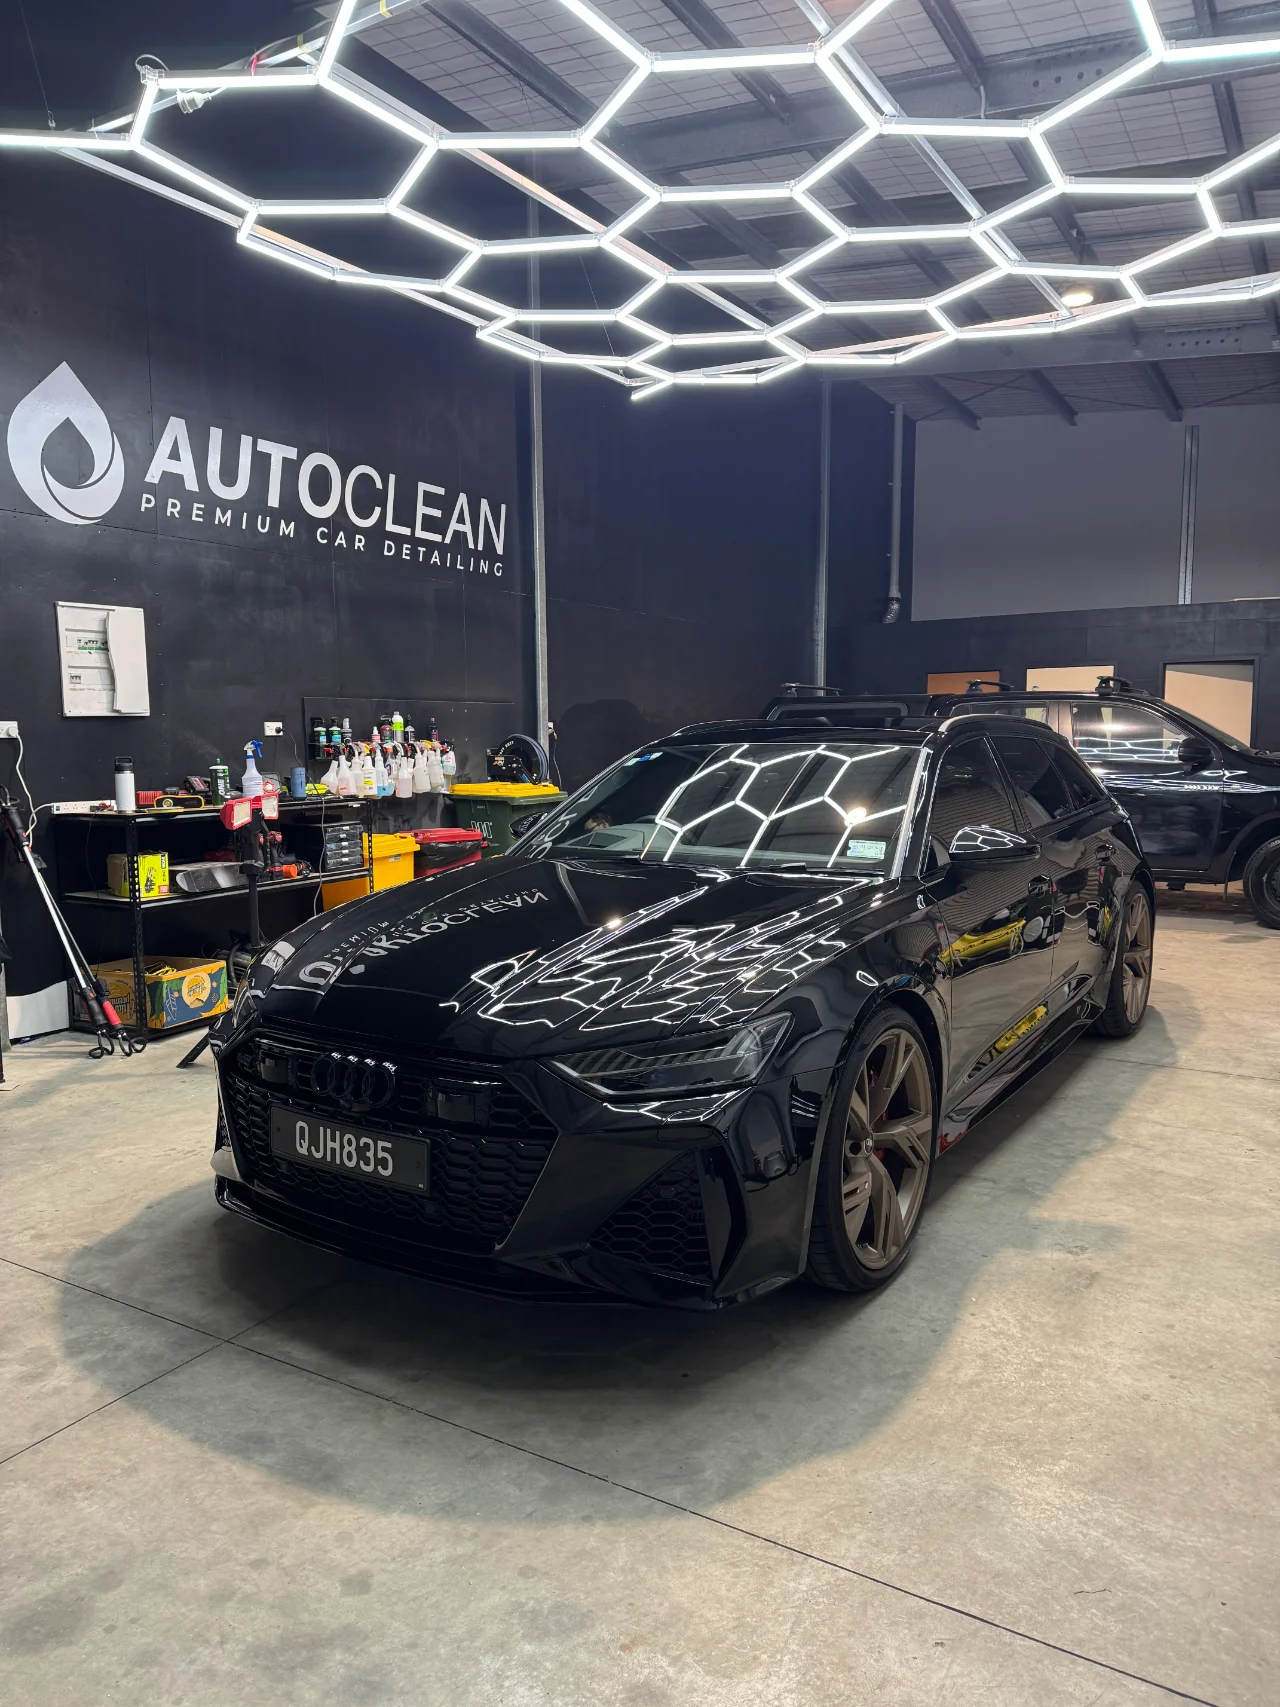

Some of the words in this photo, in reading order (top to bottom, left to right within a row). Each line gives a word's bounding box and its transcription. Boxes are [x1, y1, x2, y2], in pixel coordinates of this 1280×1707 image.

[144, 415, 507, 556] AUTOCLEAN
[140, 493, 295, 538] PREMIUM
[316, 527, 366, 551] CAR
[383, 540, 503, 577] DETAILING
[294, 1120, 394, 1177] QJH835
